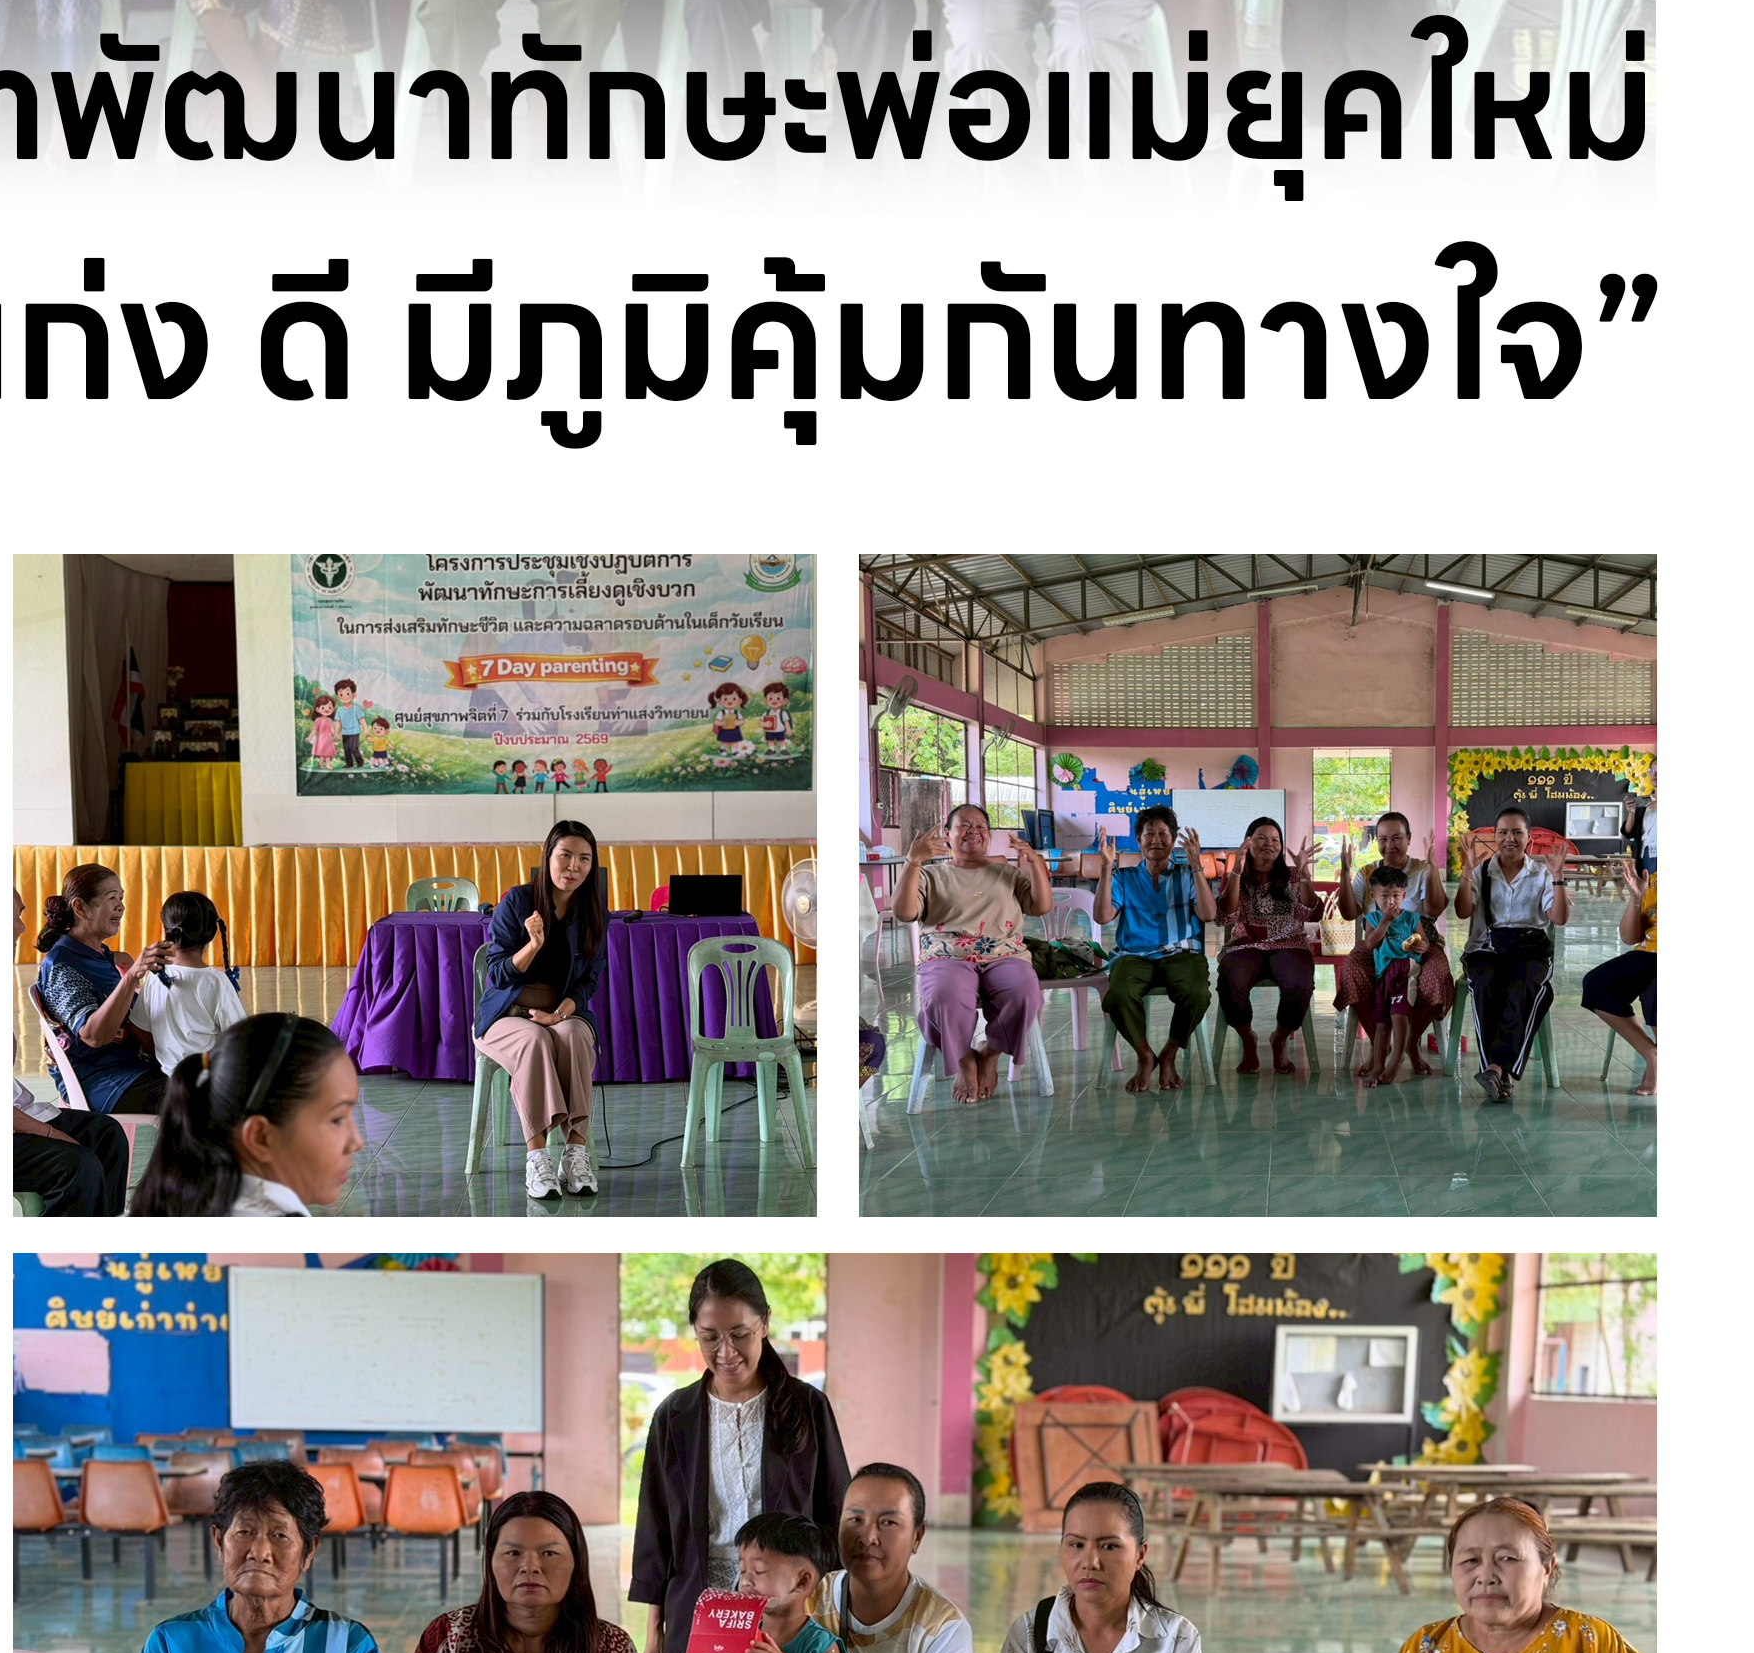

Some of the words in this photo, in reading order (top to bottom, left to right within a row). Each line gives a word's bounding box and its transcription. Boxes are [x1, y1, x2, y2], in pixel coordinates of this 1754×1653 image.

[418, 571, 695, 611] พัฒนาทักษะการเลี้ยงดูเชิงบวก
[337, 616, 508, 635] ในการส่งเสริมทักษะชีวิต
[513, 613, 784, 633] และความฉลาดรอบด้านในเด็กวัยเรียน
[481, 660, 493, 675] 7
[498, 659, 535, 678] Day
[540, 658, 629, 677] parenting
[394, 705, 497, 725] ศูนย์สุขภาพจิตที่
[500, 709, 508, 720] 7
[516, 704, 709, 722] ร่วมกับโรงเรียนท่าแสงวิทยายน
[494, 732, 569, 747] ปีงบประมาณ
[576, 734, 608, 745] 2569
[708, 1609, 755, 1620] BAKERY
[719, 1618, 753, 1629] SRIFA
